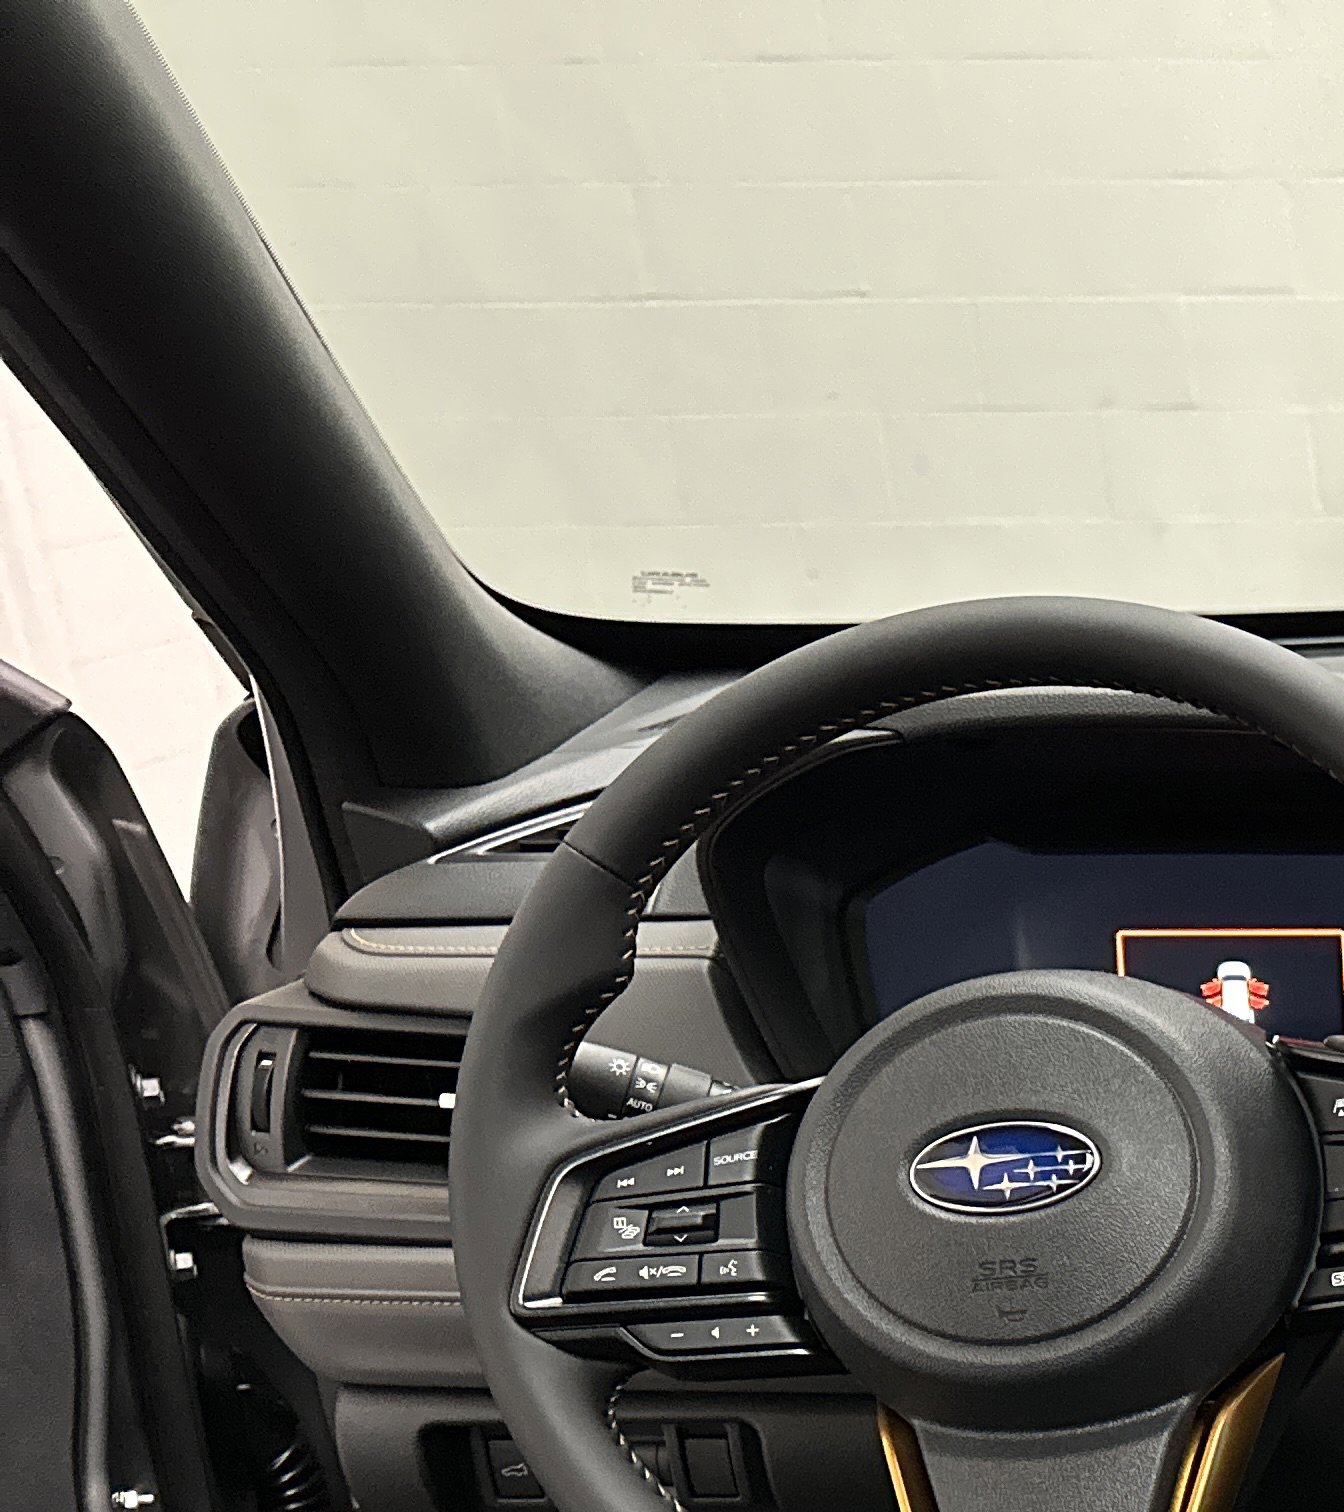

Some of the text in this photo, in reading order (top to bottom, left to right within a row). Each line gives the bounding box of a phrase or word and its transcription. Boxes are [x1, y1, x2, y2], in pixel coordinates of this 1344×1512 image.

[626, 1097, 653, 1111] AUTO
[713, 1149, 758, 1166] SOURCE
[978, 1257, 1039, 1276] SRS
[972, 1277, 1048, 1293] AIRBAG
